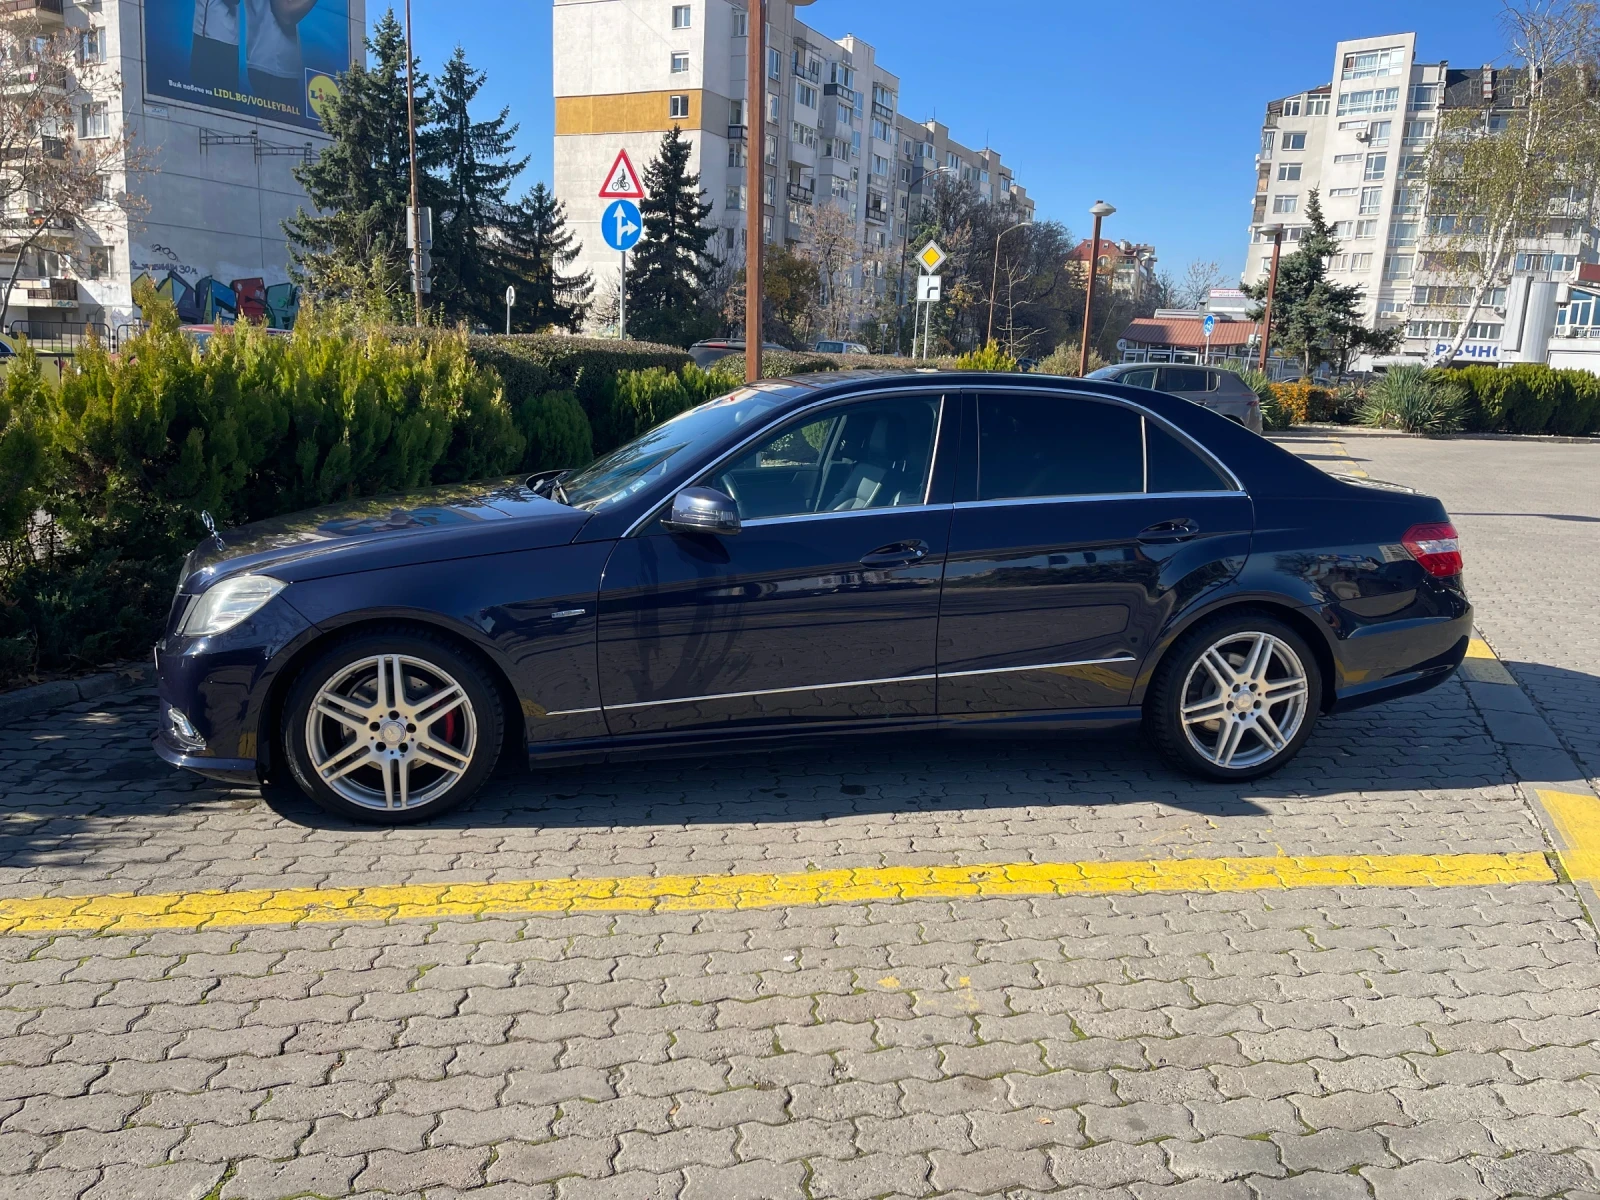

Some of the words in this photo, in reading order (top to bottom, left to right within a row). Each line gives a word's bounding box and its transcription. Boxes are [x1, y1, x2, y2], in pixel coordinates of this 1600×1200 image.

[168, 79, 182, 88] Виж
[183, 84, 204, 93] повече
[213, 87, 301, 116] LIDL.BG/VOLLEYBALL
